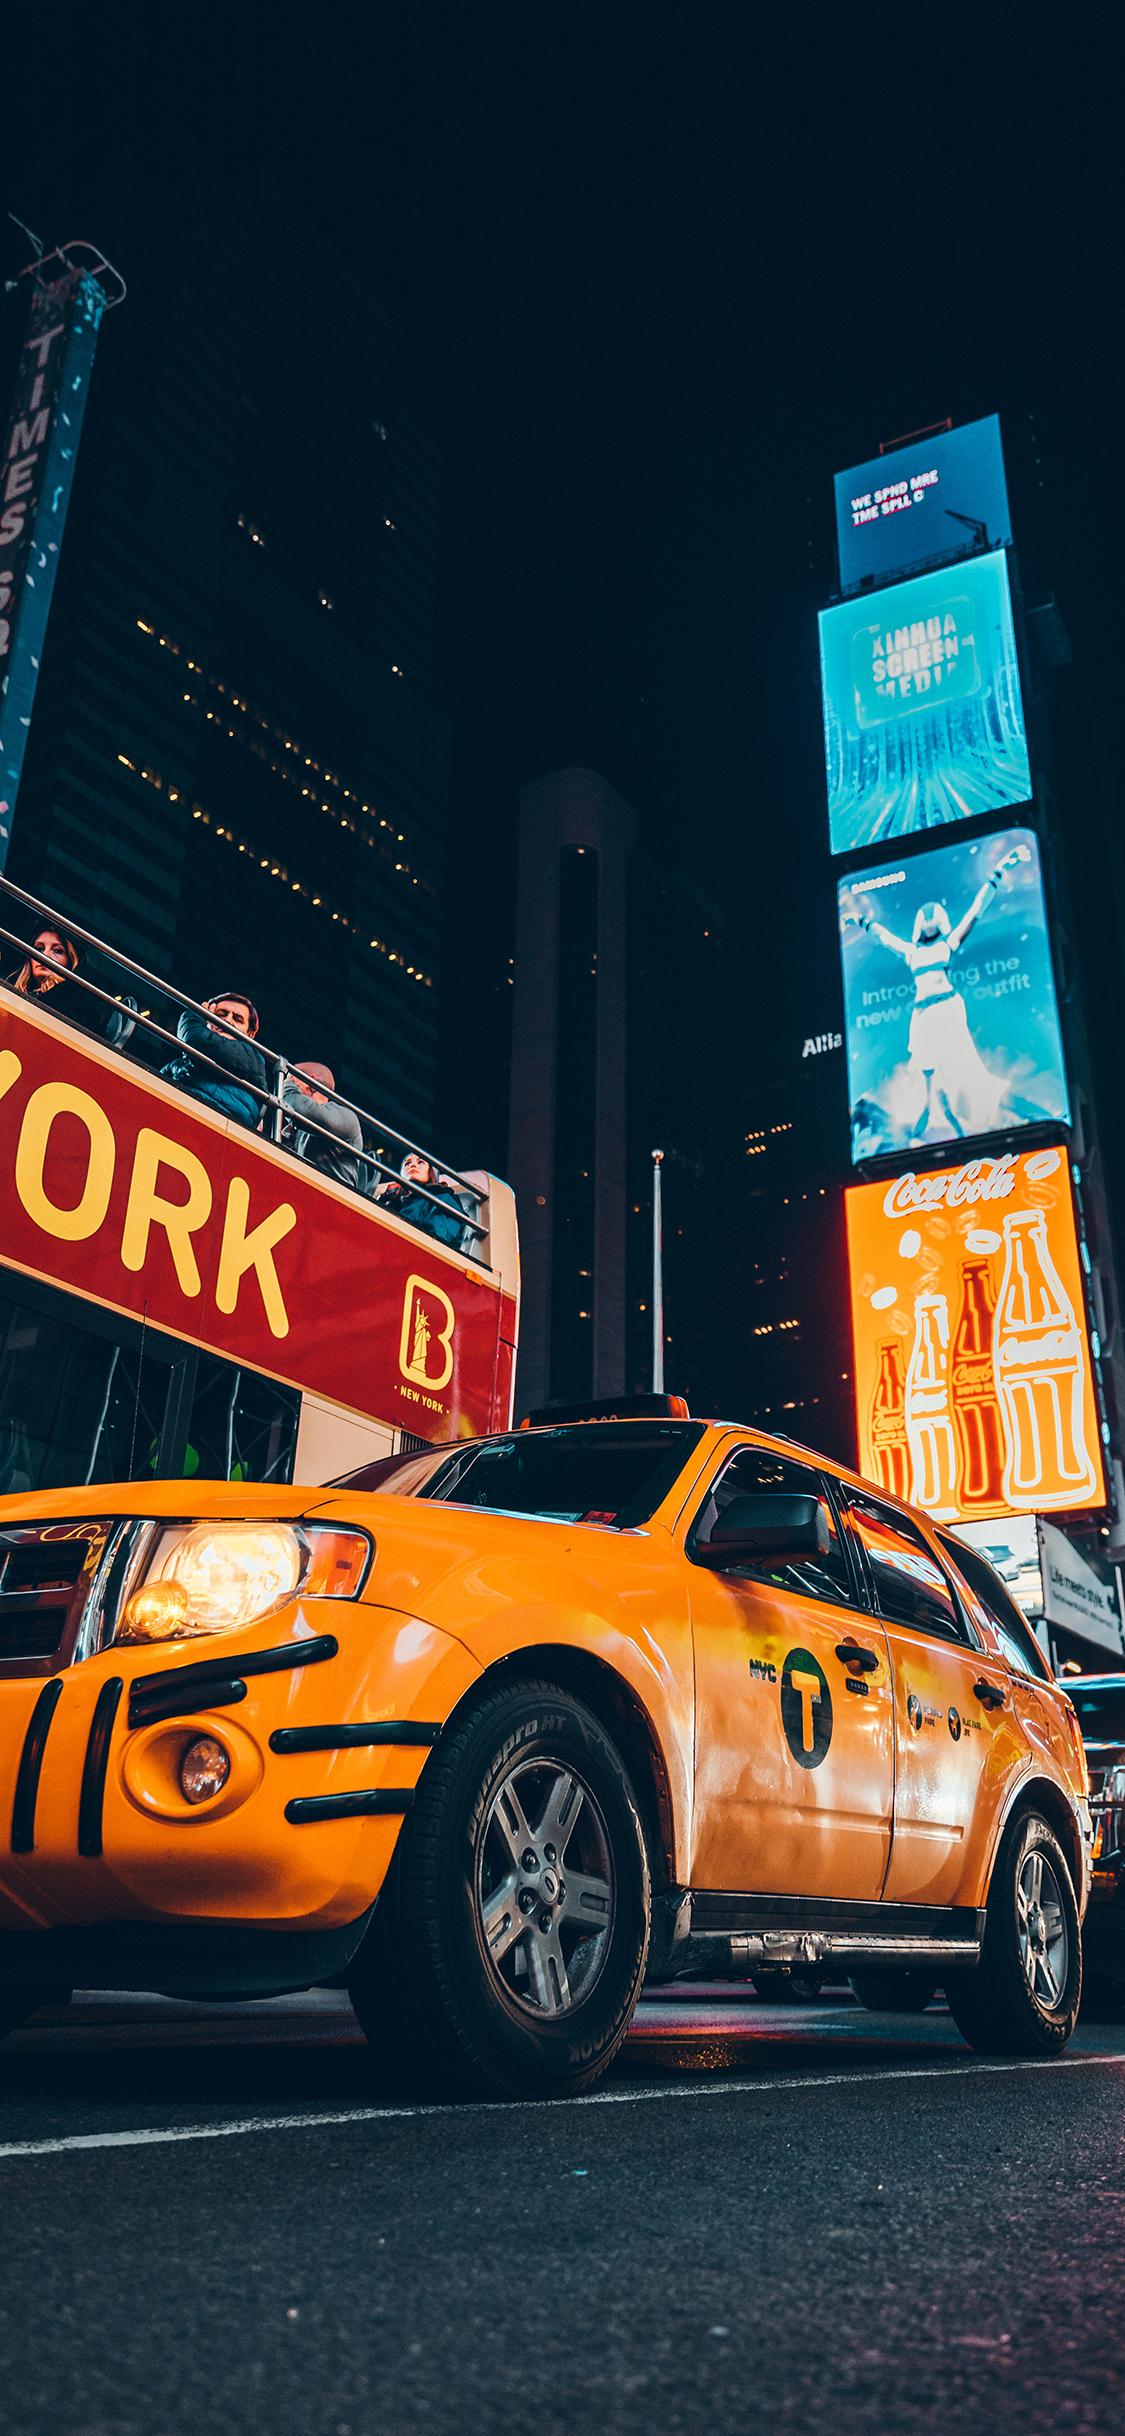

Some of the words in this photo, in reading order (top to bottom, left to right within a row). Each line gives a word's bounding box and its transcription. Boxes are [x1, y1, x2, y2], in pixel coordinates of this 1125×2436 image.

[0, 324, 65, 546] TIMES
[850, 493, 872, 511] WE
[910, 469, 939, 491] MRE
[851, 505, 880, 525] TME
[881, 494, 912, 515] SPLL
[913, 489, 924, 503] C
[872, 613, 957, 658] XINHUA
[872, 635, 959, 683] SCREEN
[983, 957, 1020, 976] the
[856, 1006, 902, 1029] new
[972, 973, 1032, 1000] outfit
[399, 1273, 455, 1391] B
[401, 1385, 421, 1404] NEW
[422, 1395, 444, 1415] YORK
[542, 1714, 567, 1732] HT
[749, 1658, 777, 1684] NYC
[791, 1669, 821, 1753] T
